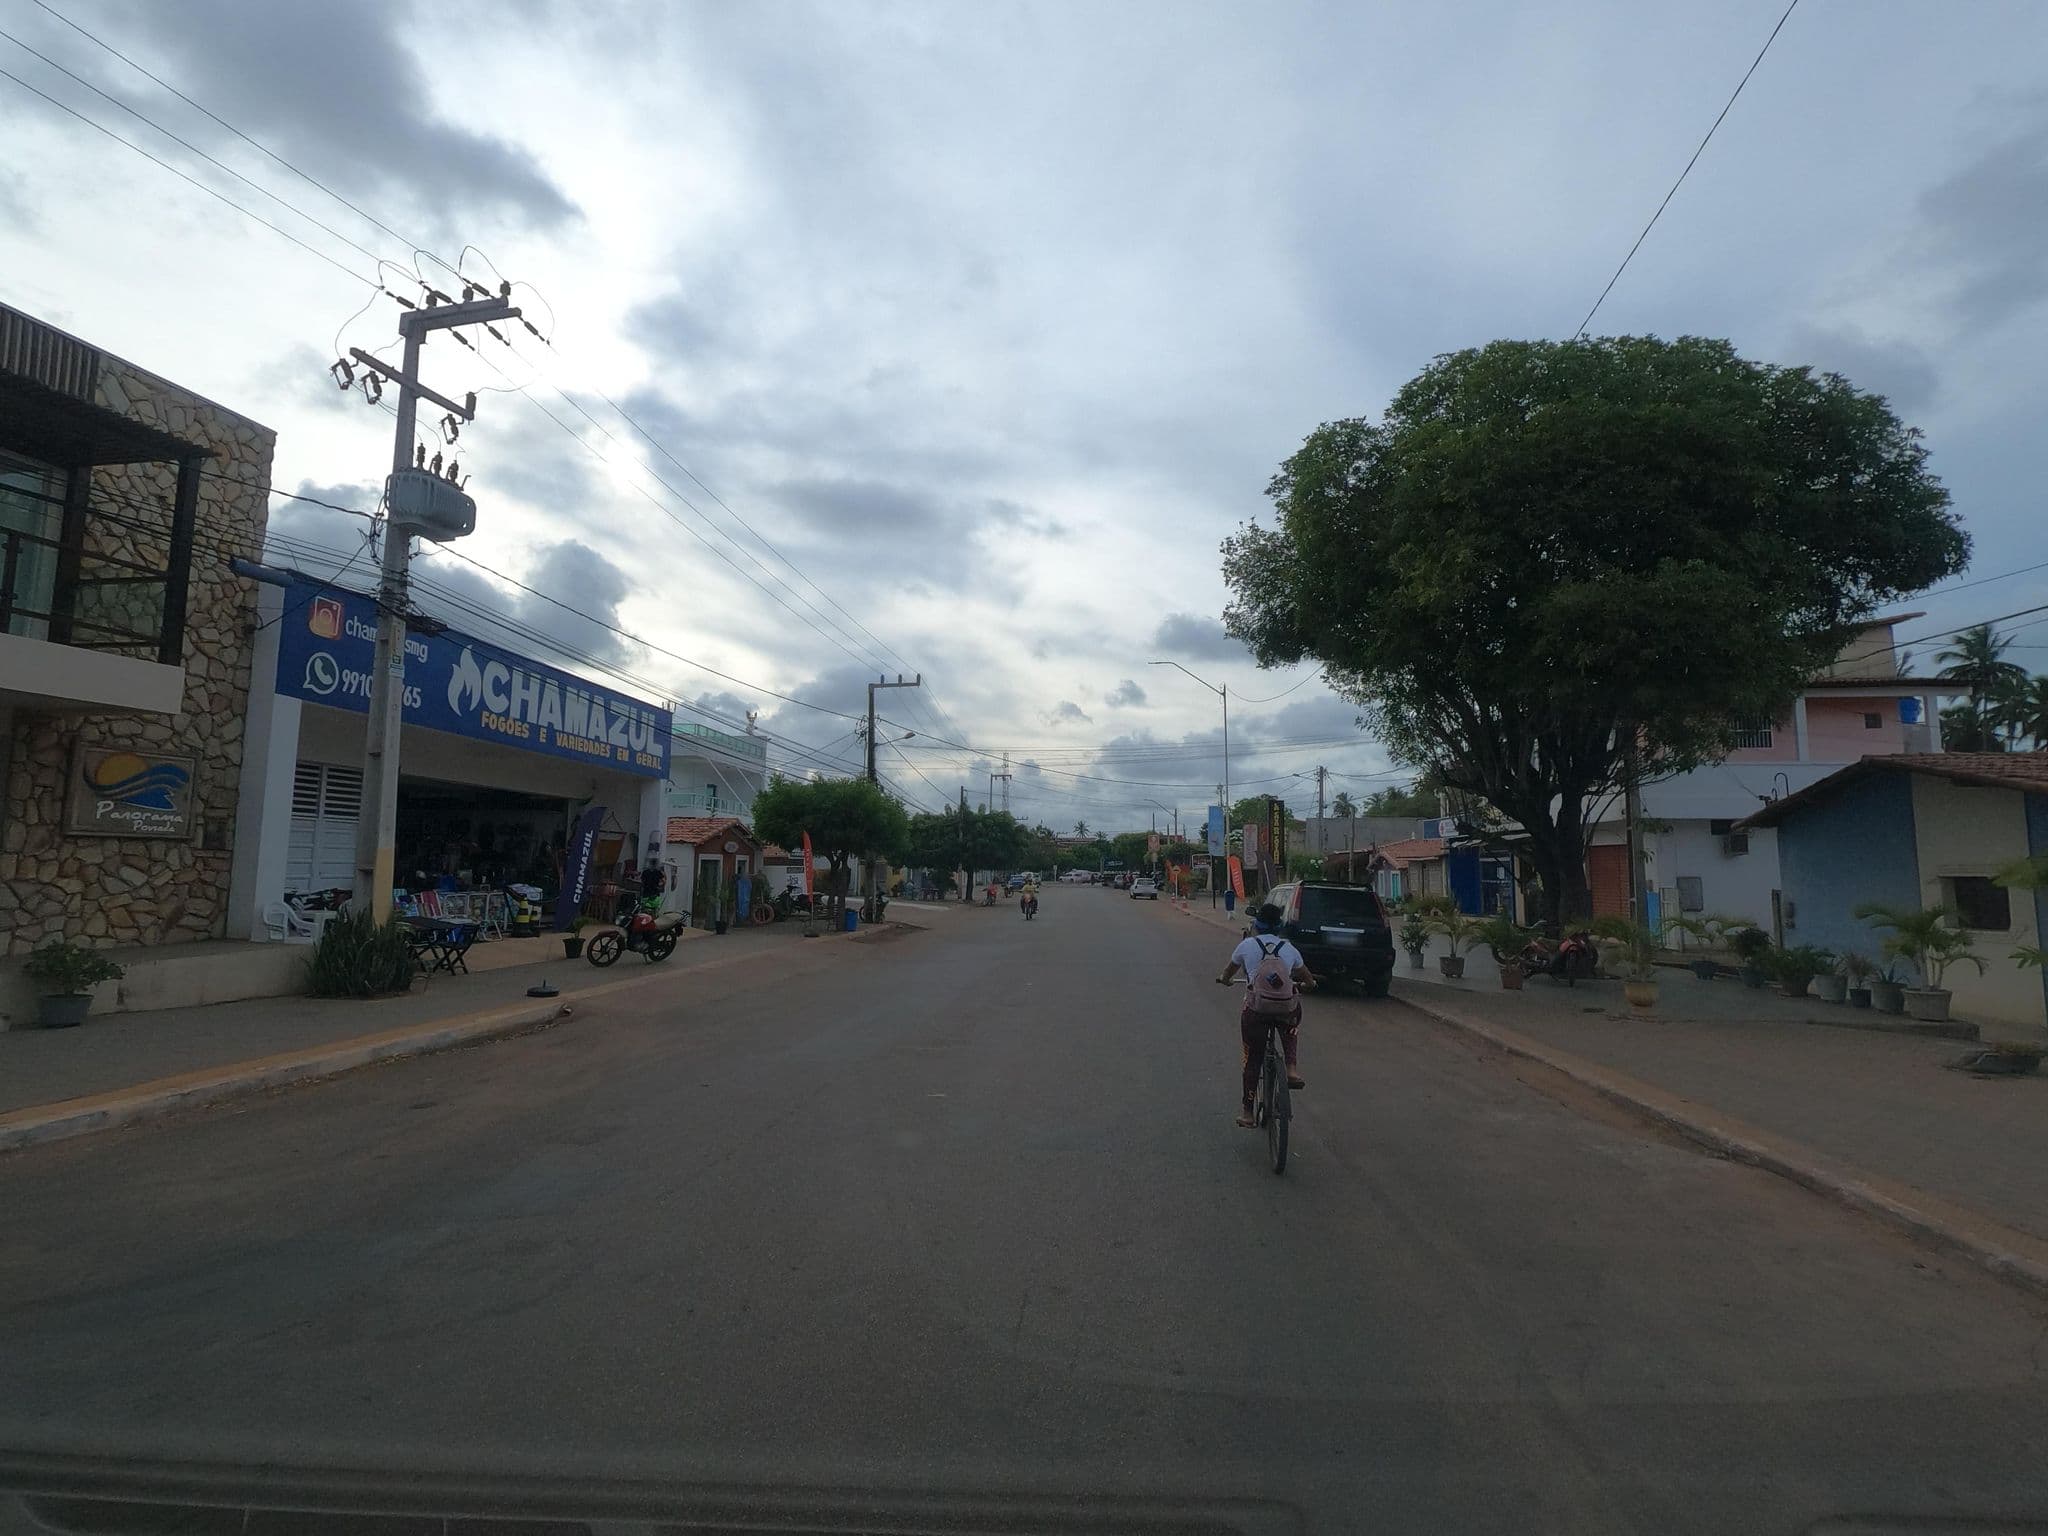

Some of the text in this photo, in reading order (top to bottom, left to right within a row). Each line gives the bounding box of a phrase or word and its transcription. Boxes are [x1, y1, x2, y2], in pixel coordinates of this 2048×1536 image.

[483, 661, 663, 757] CHAMAZUL
[539, 728, 547, 743] E
[556, 732, 610, 758] VARIEDADES
[617, 748, 630, 762] EM
[636, 753, 662, 769] GERAL
[96, 801, 184, 823] Panorama
[573, 829, 594, 904] CHAMAZUL
